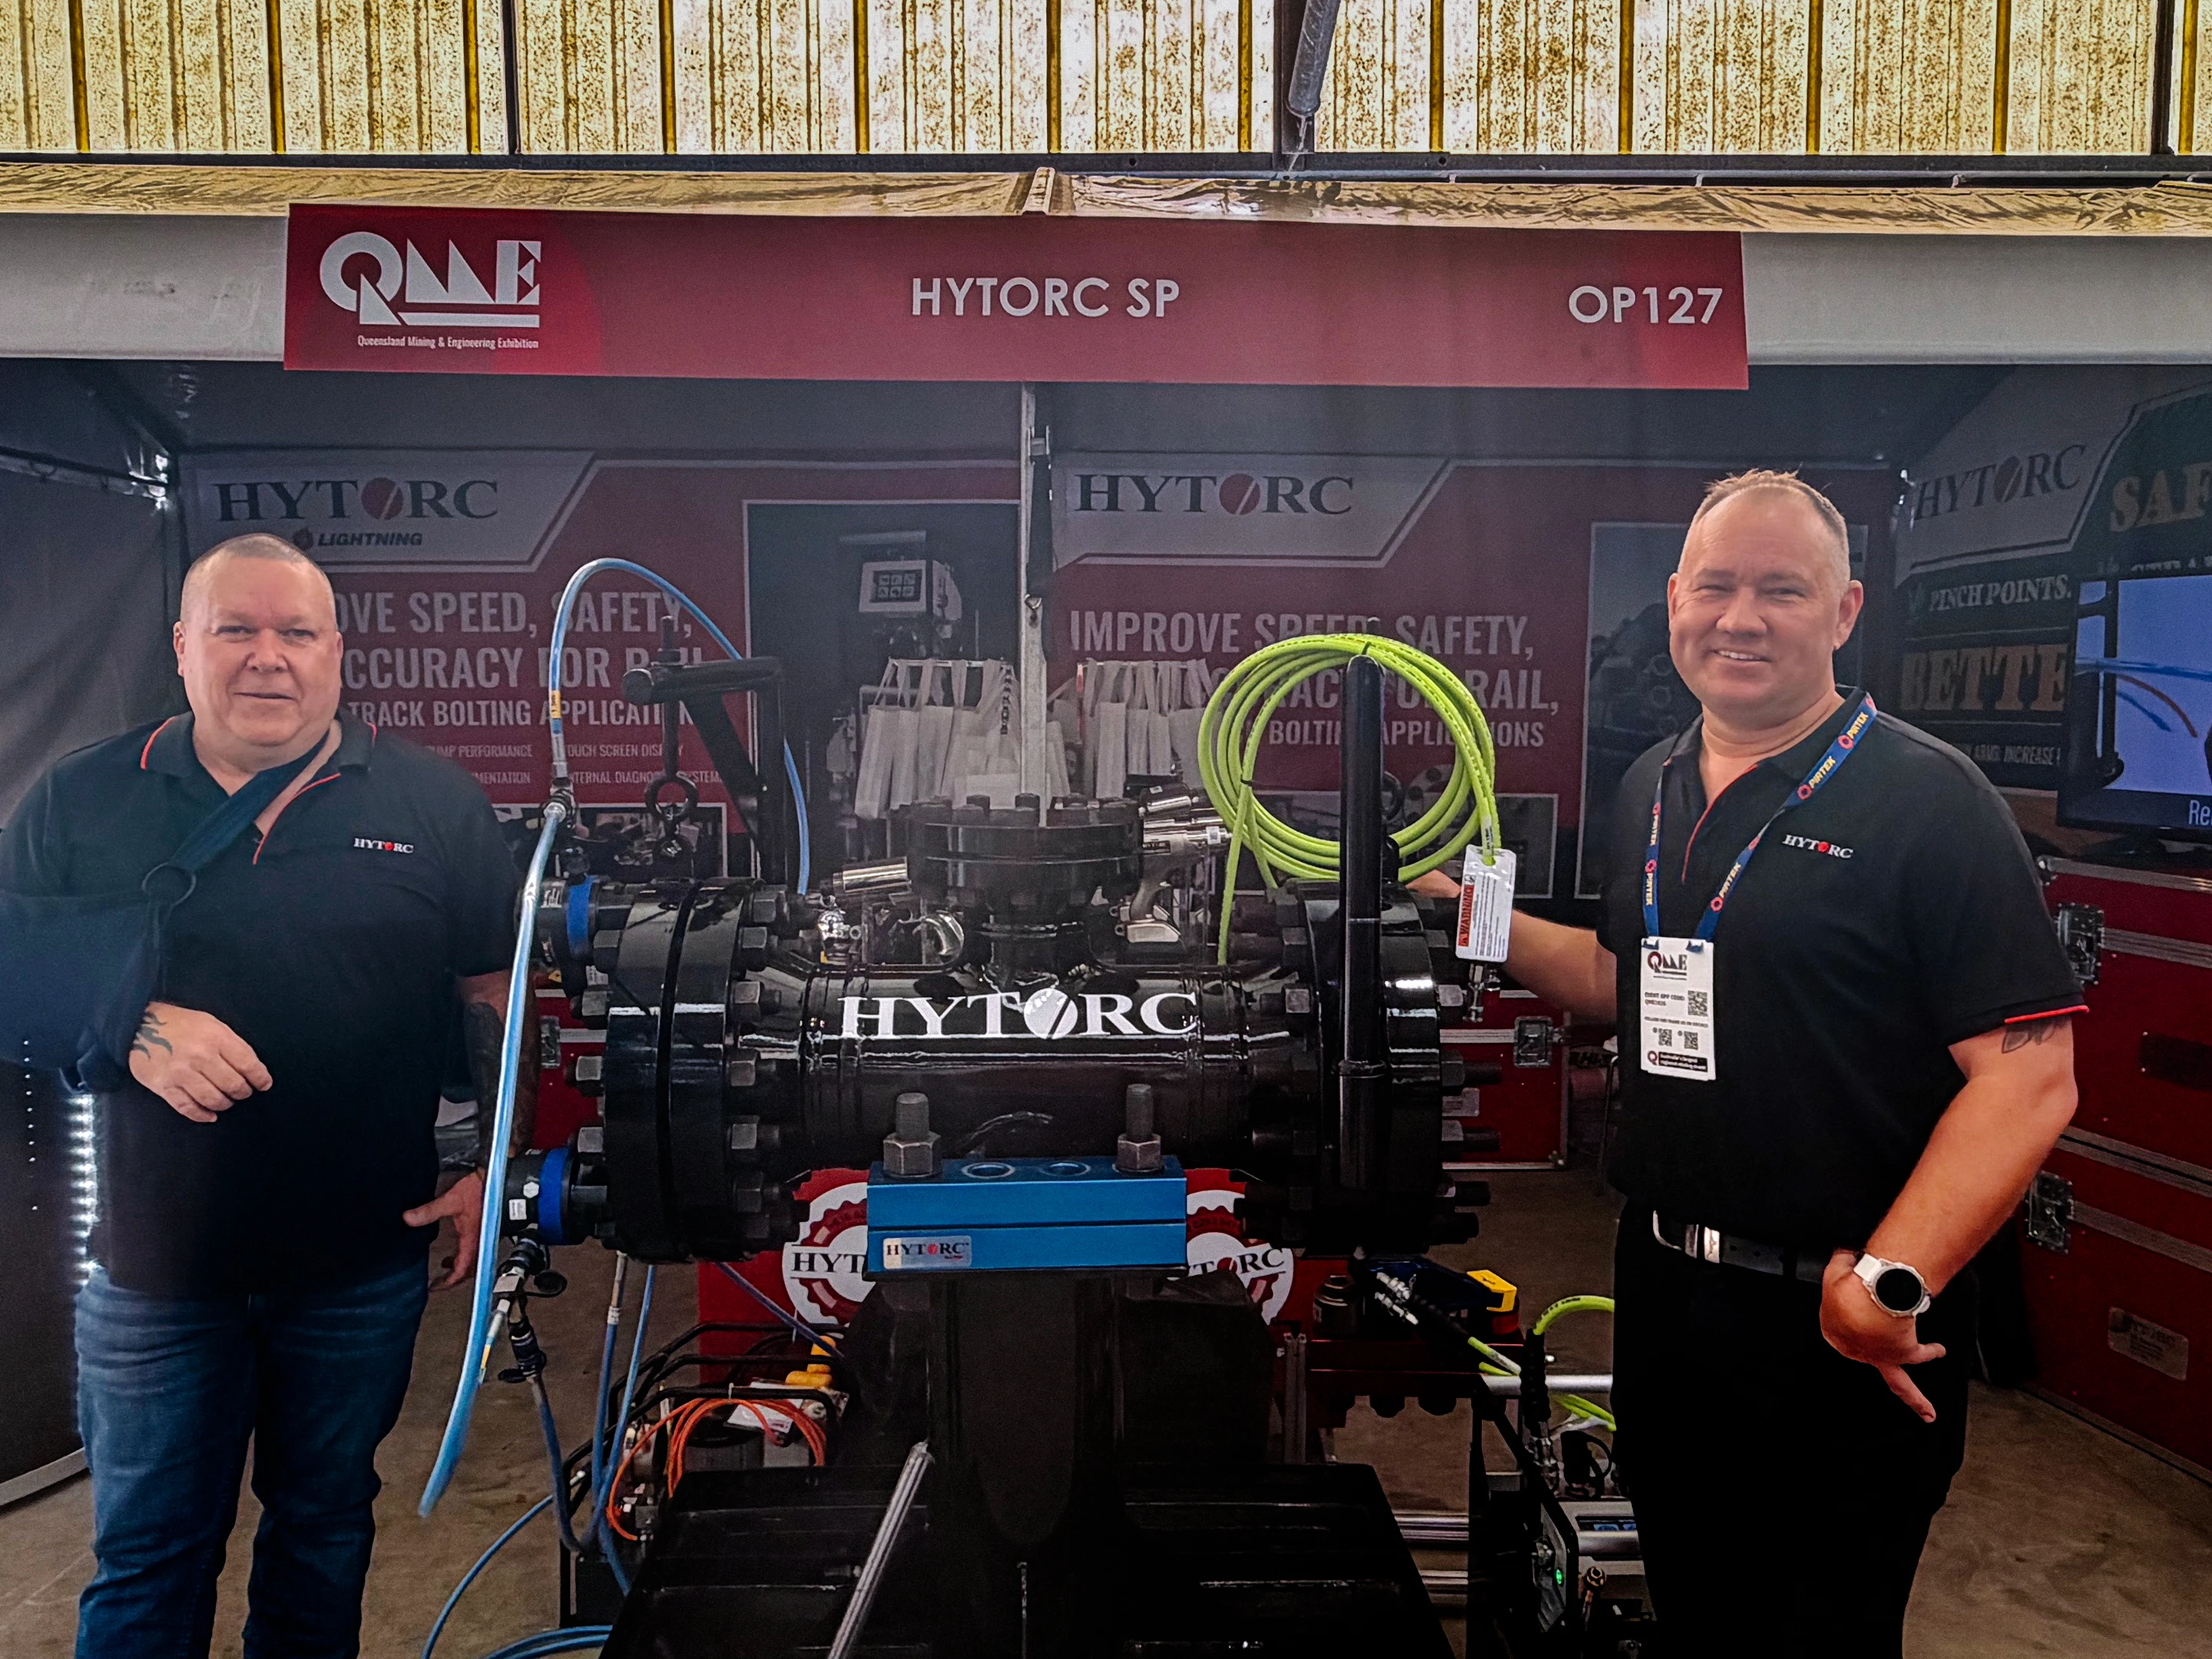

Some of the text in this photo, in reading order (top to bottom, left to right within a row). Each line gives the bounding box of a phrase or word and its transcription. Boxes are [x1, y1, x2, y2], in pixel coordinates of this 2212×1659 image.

[319, 231, 541, 326] QME
[912, 276, 1181, 318] HYTORC SP
[1568, 285, 1724, 325] OP127
[357, 334, 540, 351] Queensland Mining & Engineering Exhibition
[211, 476, 498, 522] HYTORC
[1074, 472, 1354, 516] HYTORC
[317, 531, 423, 548] LIGHTNING
[1985, 573, 2072, 608] POINTS.
[407, 591, 538, 638] SPEED,
[1070, 611, 1240, 654] IMPROVE
[1395, 614, 1534, 660] SAFETY,
[1465, 667, 1559, 717] RAIL,
[432, 699, 532, 727] BOLTING
[458, 744, 534, 758] PERFORMANCE
[565, 743, 598, 757] OUCH
[599, 743, 638, 757] SCREEN
[472, 771, 531, 784] MENTATION
[2188, 799, 2212, 826] Re
[353, 837, 415, 854] HYTORC
[1781, 834, 1854, 859] HYTORC
[836, 988, 1199, 1040] HYTORC
[886, 1242, 966, 1256] HYTORC
